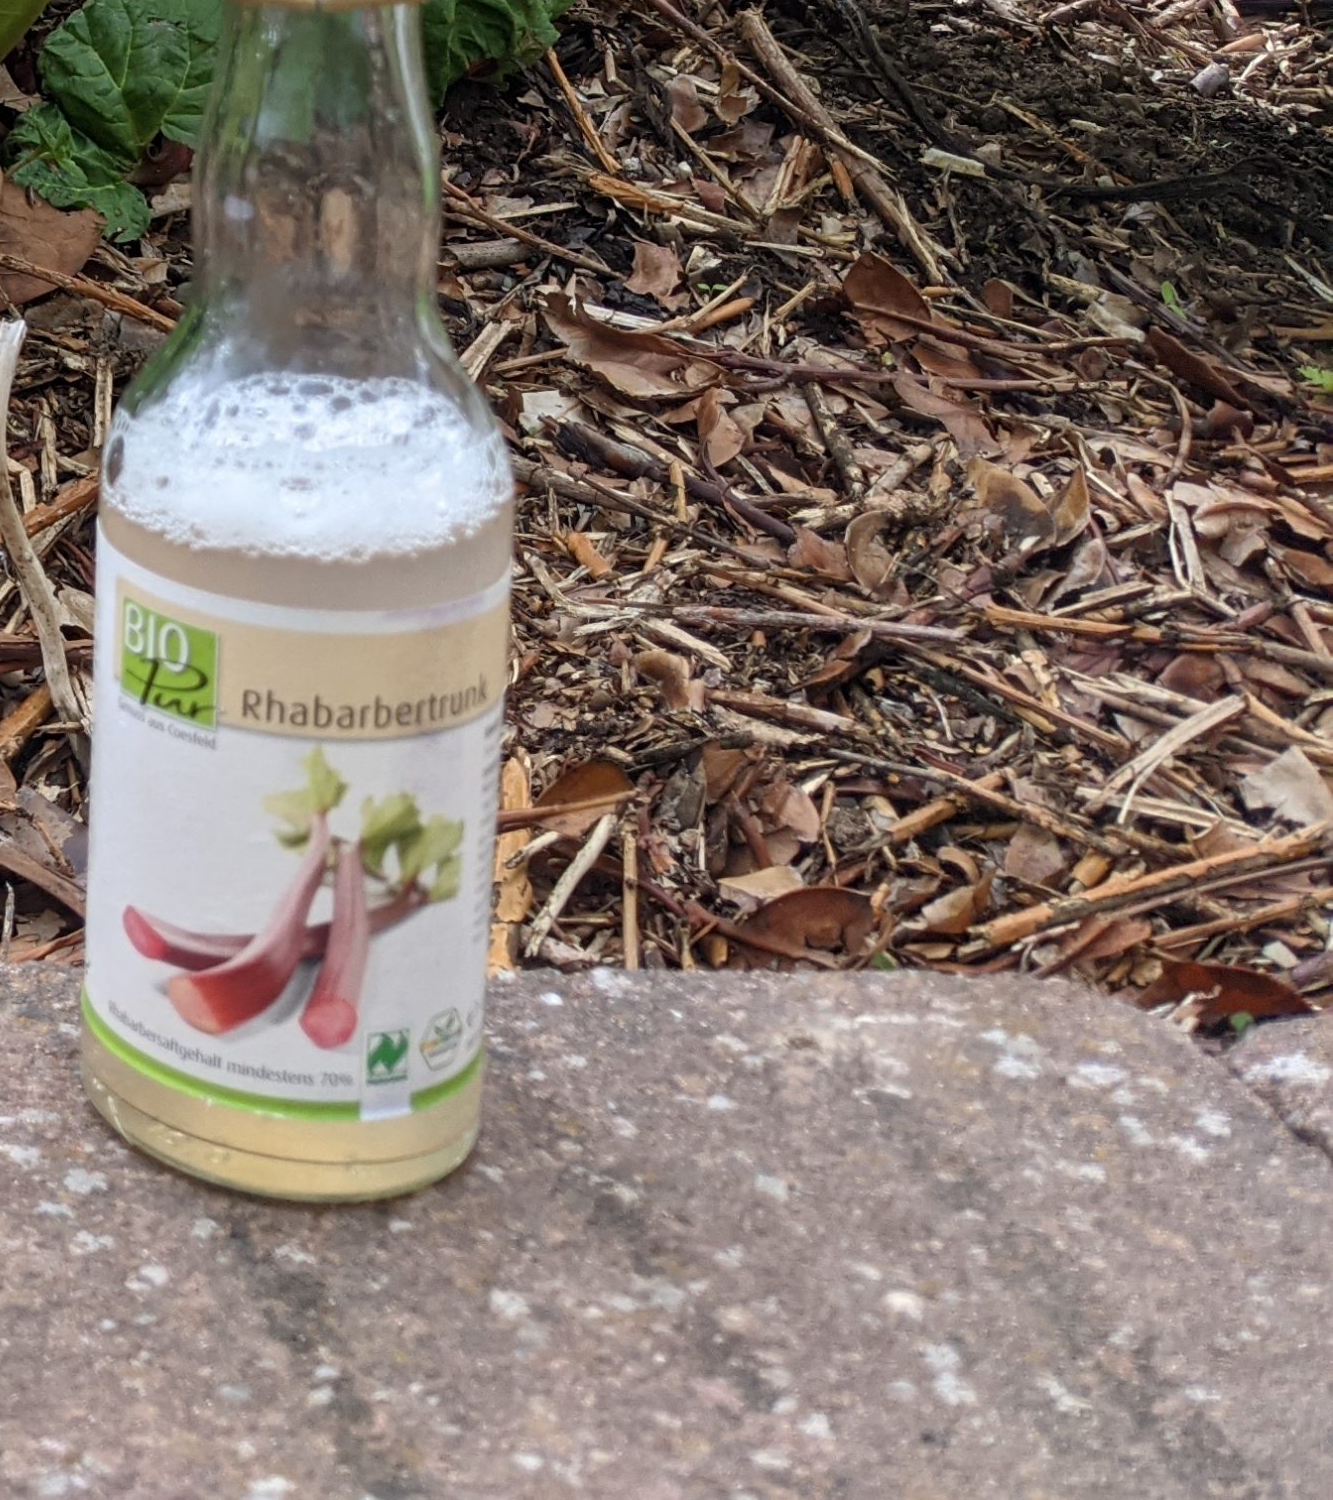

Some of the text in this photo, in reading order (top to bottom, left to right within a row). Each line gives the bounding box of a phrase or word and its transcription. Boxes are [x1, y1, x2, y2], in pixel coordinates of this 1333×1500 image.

[124, 603, 189, 673] BIO
[126, 658, 217, 719] Pur
[241, 674, 488, 729] Rhabarbertrunk
[226, 1060, 314, 1086] mindestens
